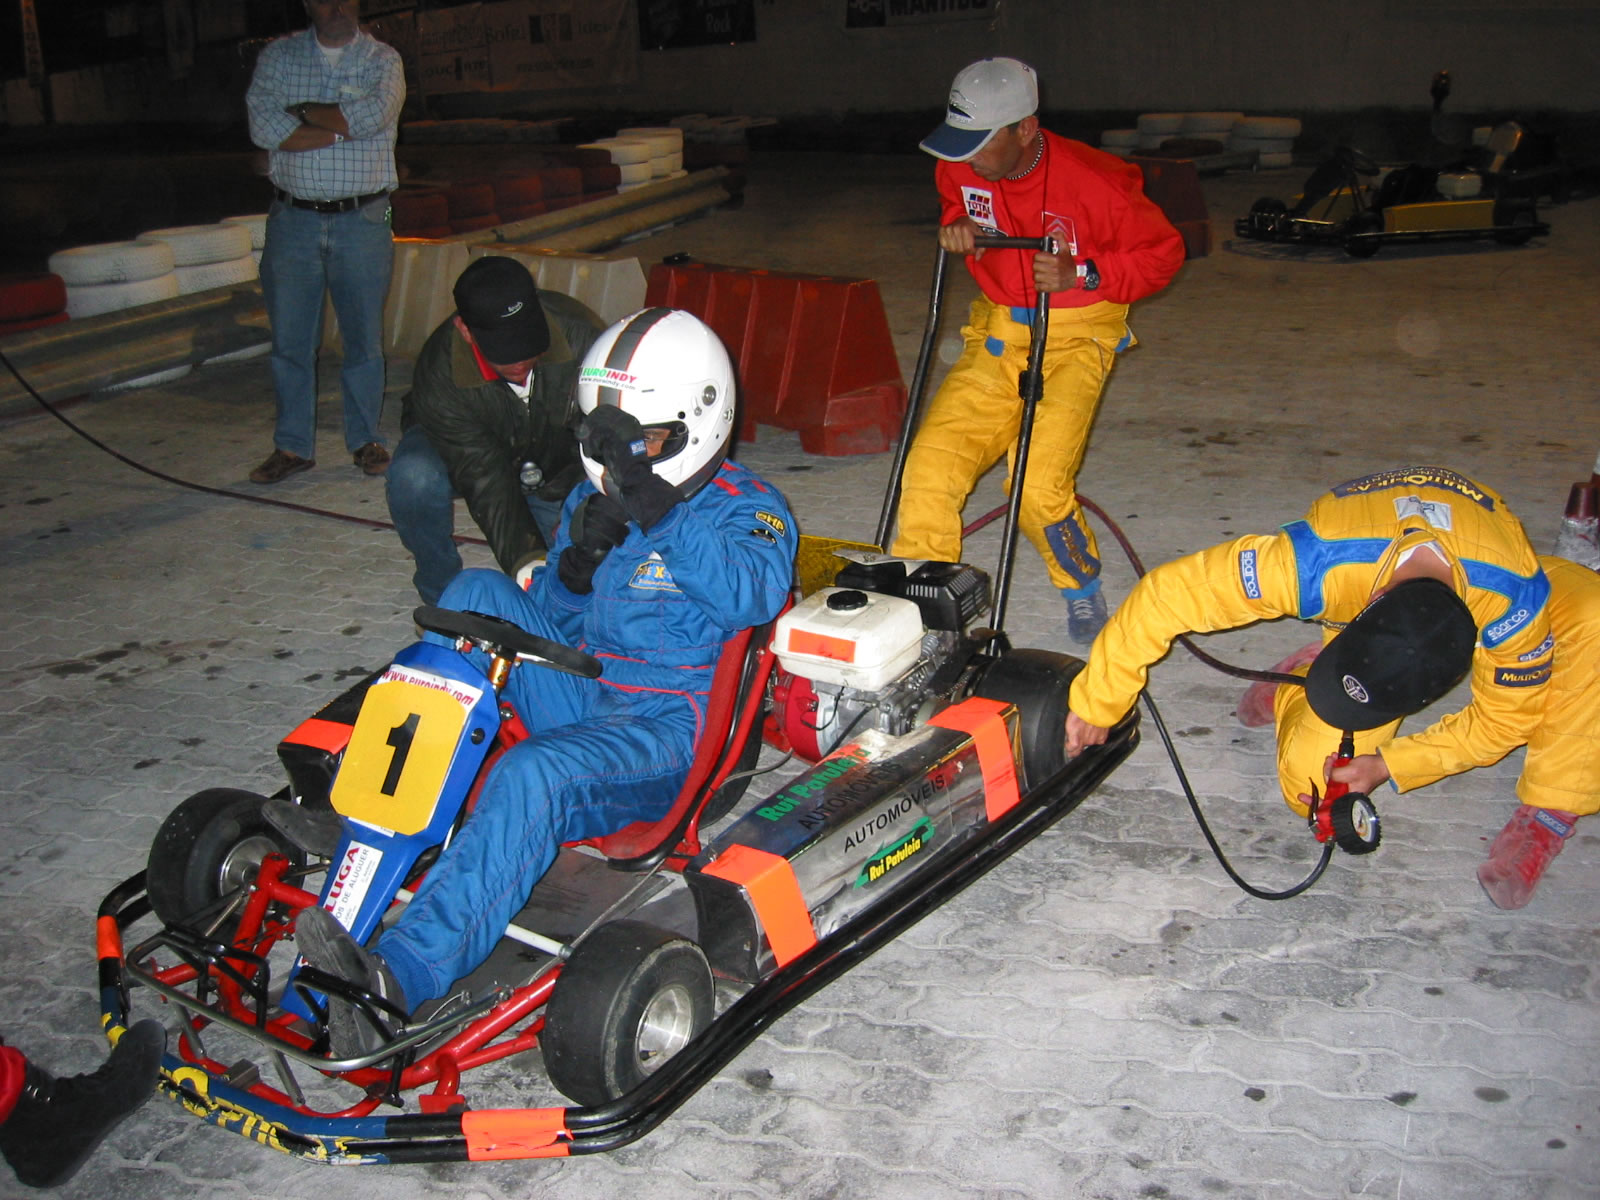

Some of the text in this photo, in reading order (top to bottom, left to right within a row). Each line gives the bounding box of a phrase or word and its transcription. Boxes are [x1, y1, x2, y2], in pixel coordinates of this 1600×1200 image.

[966, 200, 992, 215] TOTAL
[582, 367, 638, 384] EUROINDY
[1240, 551, 1259, 598] sparco
[1487, 608, 1529, 642] sparco
[380, 712, 422, 798] 1
[755, 794, 801, 822] Rui
[341, 891, 352, 904] DE
[349, 848, 369, 888] ALUGUER
[869, 837, 921, 882] Rui Patuleia
